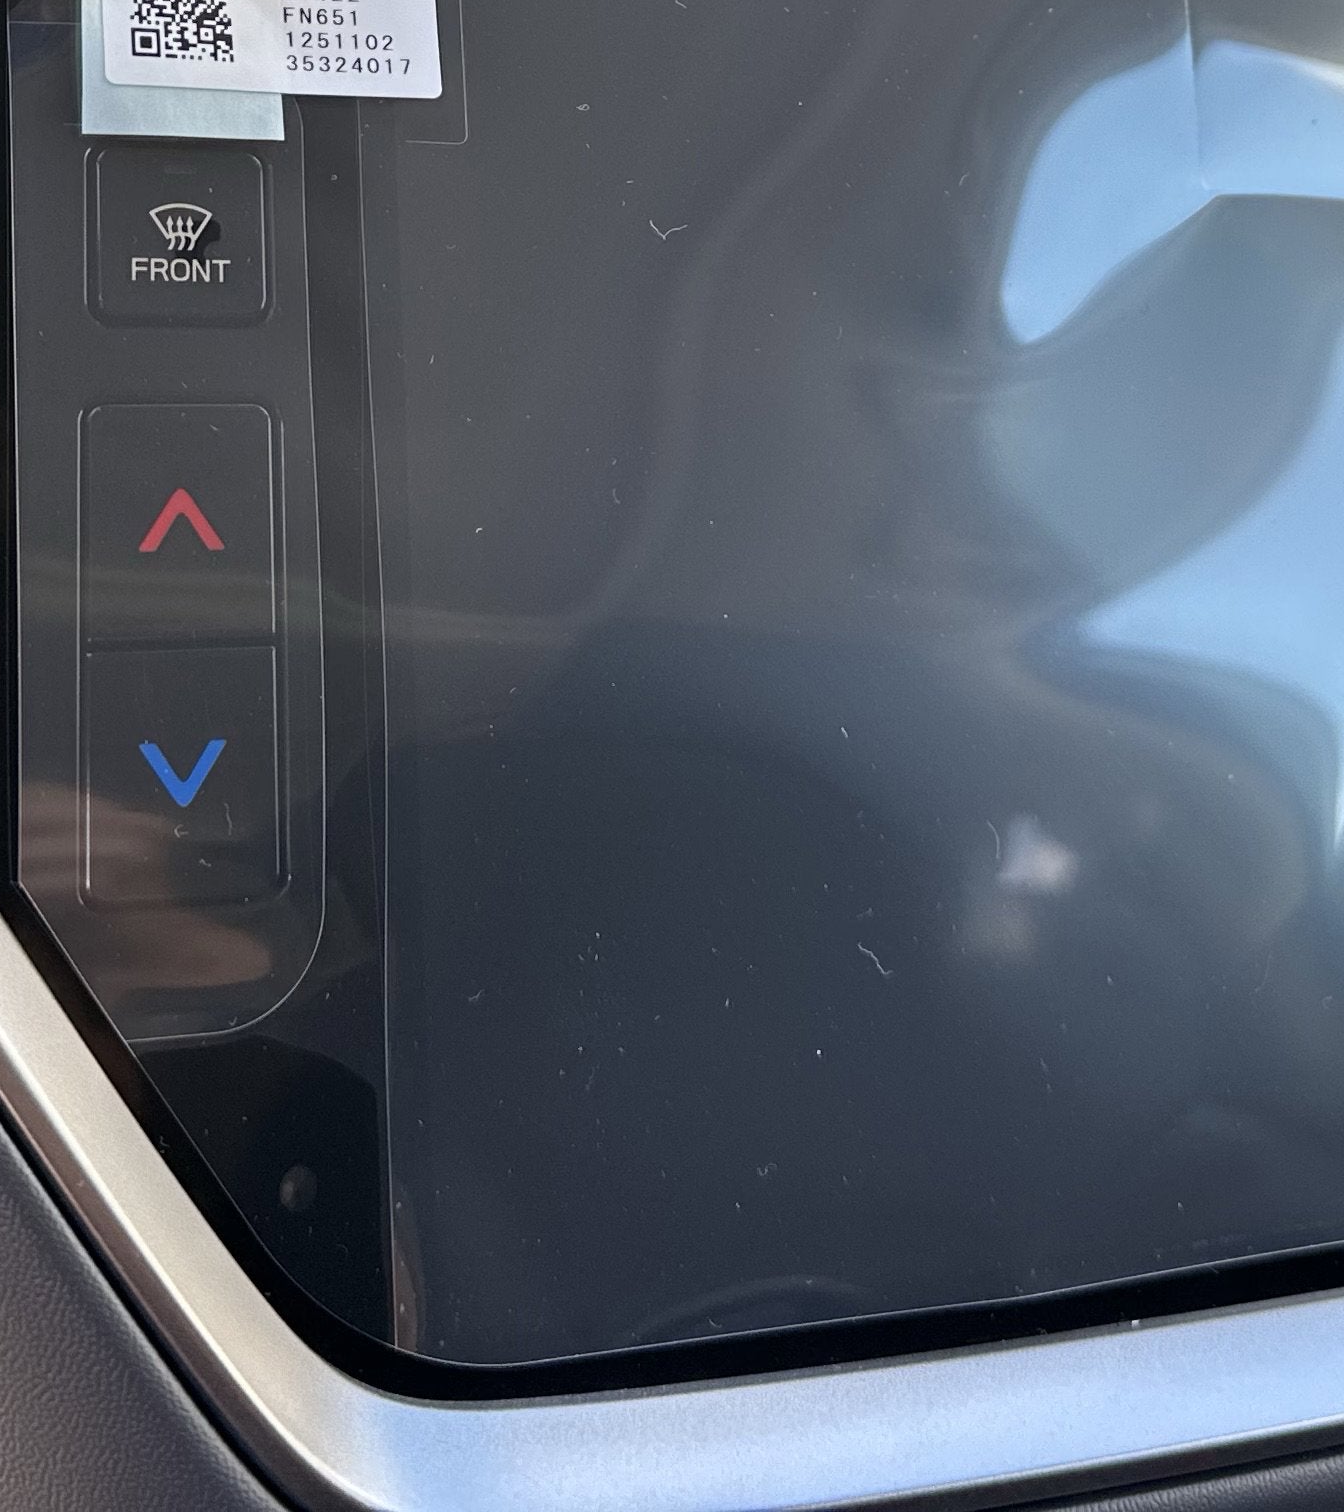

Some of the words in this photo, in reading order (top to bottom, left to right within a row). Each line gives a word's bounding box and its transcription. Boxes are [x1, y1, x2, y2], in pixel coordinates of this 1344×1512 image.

[283, 7, 357, 26] FN651
[286, 31, 394, 51] 1251102
[286, 54, 410, 75] 35324017
[131, 257, 231, 283] FRONT
